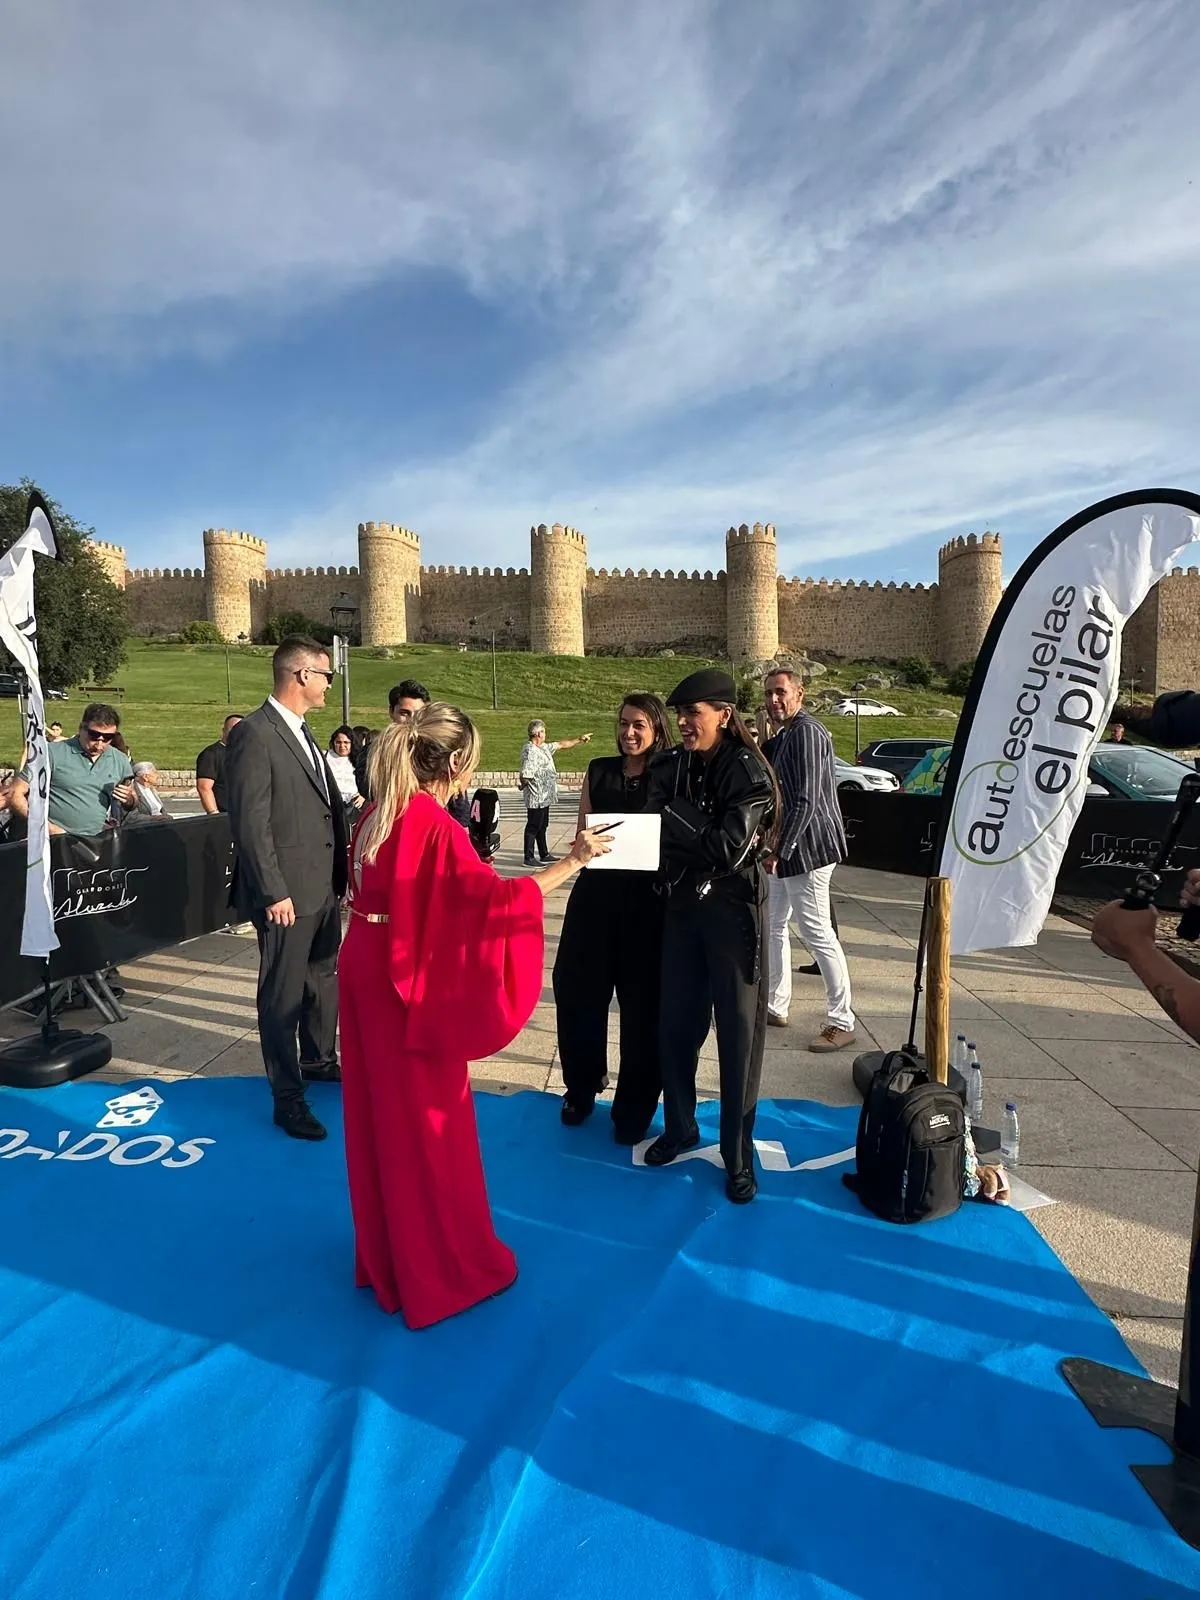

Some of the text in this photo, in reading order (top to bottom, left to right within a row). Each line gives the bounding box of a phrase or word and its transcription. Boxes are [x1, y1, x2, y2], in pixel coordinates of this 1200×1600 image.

[968, 585, 1076, 855] autoescuelas
[1032, 595, 1113, 795] el pilar
